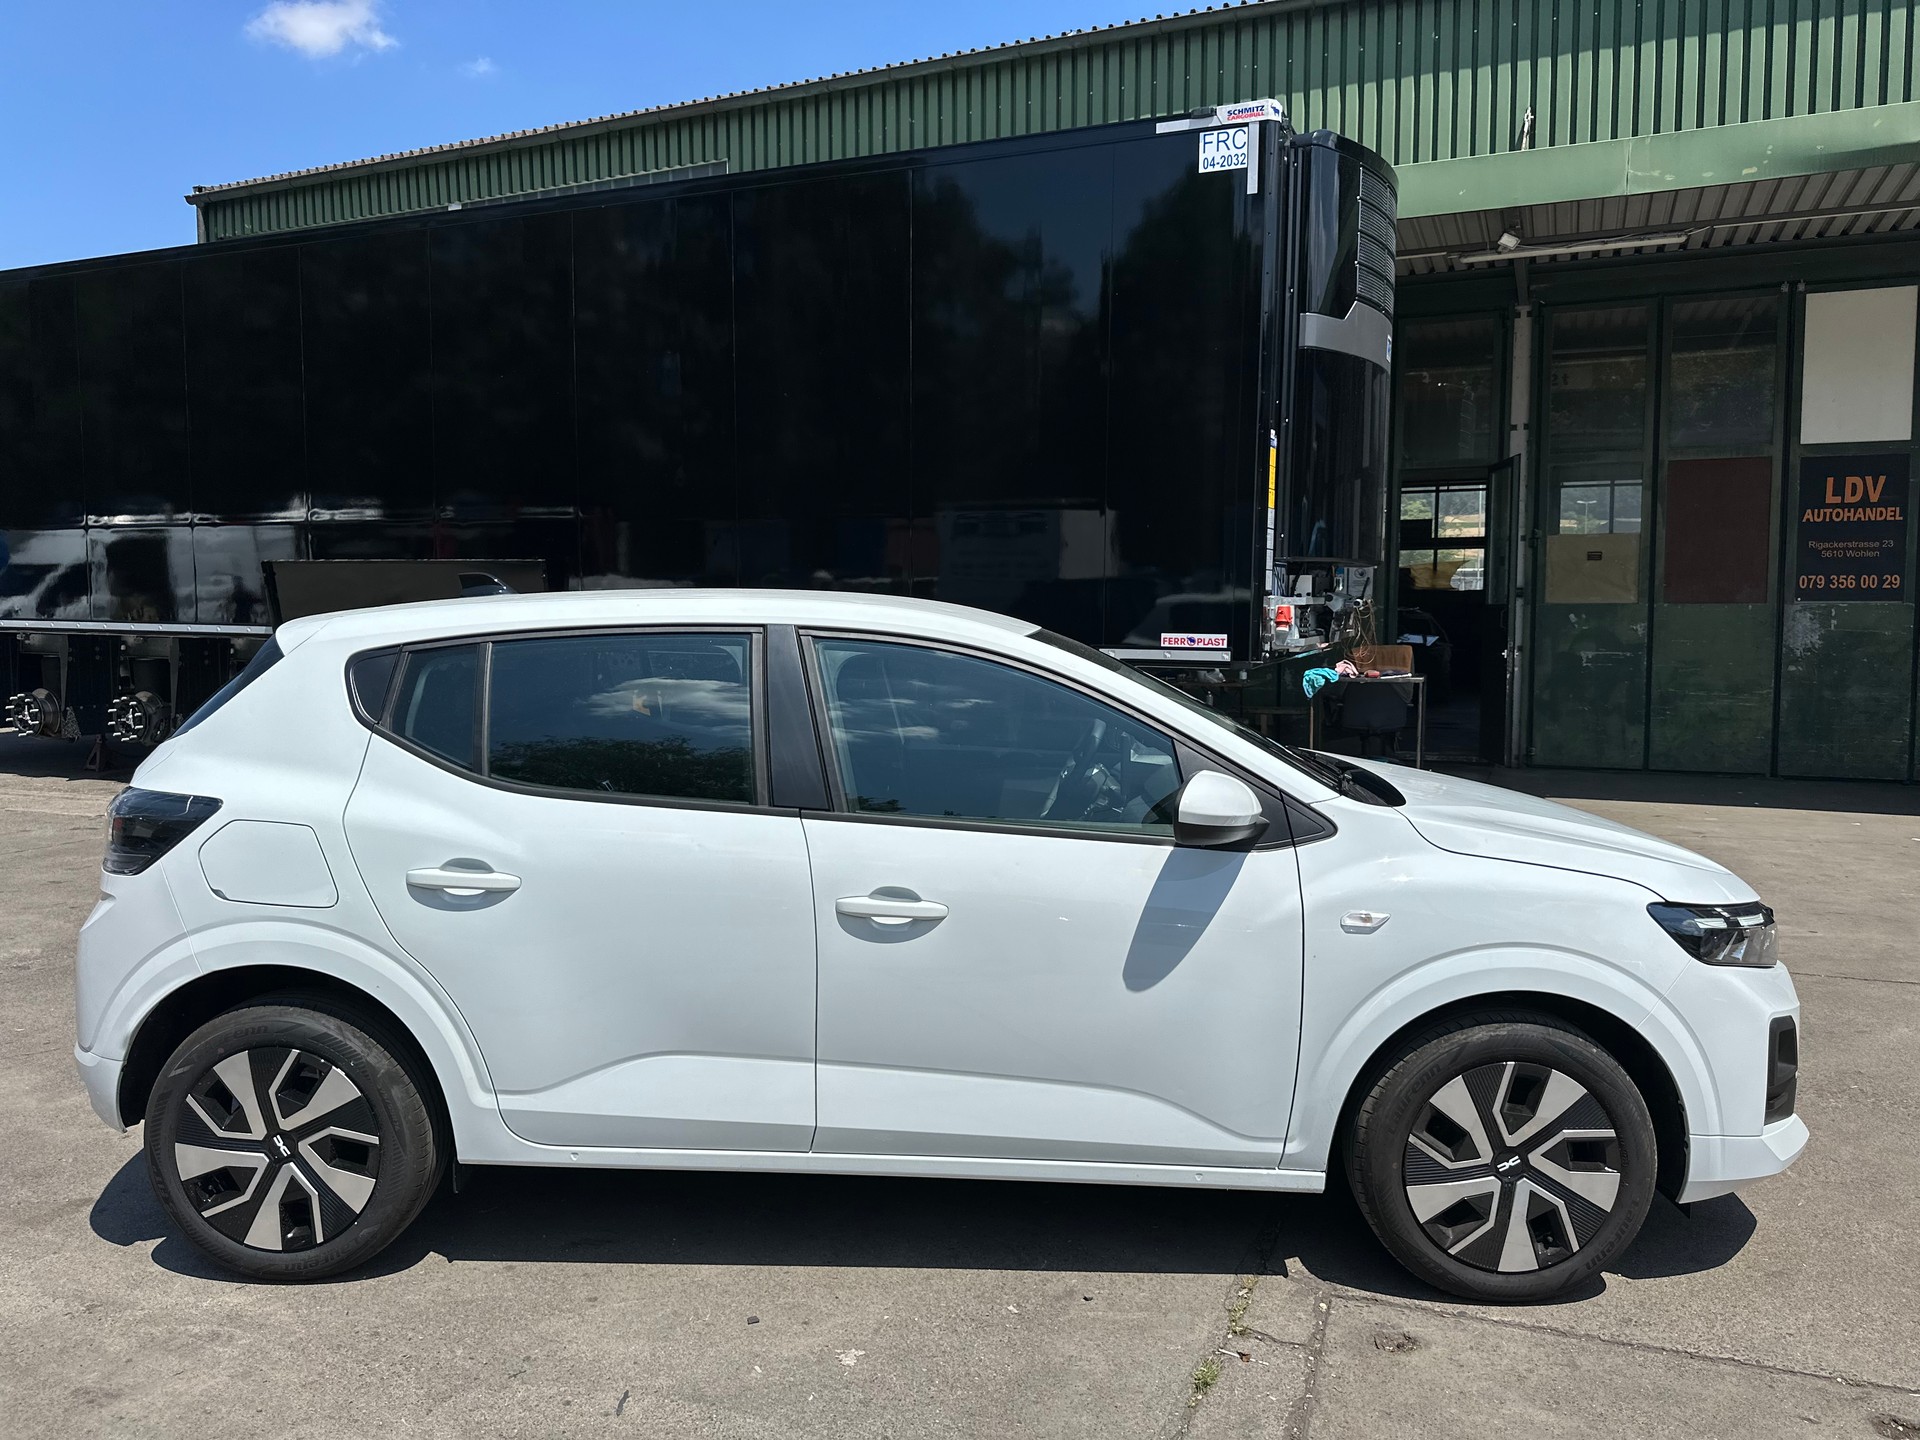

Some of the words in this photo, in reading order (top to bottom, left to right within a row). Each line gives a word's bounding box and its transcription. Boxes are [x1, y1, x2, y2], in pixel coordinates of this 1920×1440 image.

[1227, 105, 1265, 117] SCHMITZ
[1227, 111, 1265, 121] CARGOBULL
[1203, 129, 1247, 154] FRC
[1203, 153, 1247, 170] 04-2032
[1825, 475, 1887, 504] LDV
[1802, 507, 1904, 523] AUTOHANDEL
[1808, 540, 1880, 550] Rigackerstrasse
[1882, 540, 1894, 548] 23
[1821, 550, 1843, 558] 5610
[1846, 550, 1880, 558] Wohlen
[1799, 575, 1825, 589] 079
[1829, 575, 1856, 589] 356
[1860, 574, 1878, 589] 00
[1882, 574, 1901, 589] 29
[1162, 636, 1226, 647] FERROPLAST
